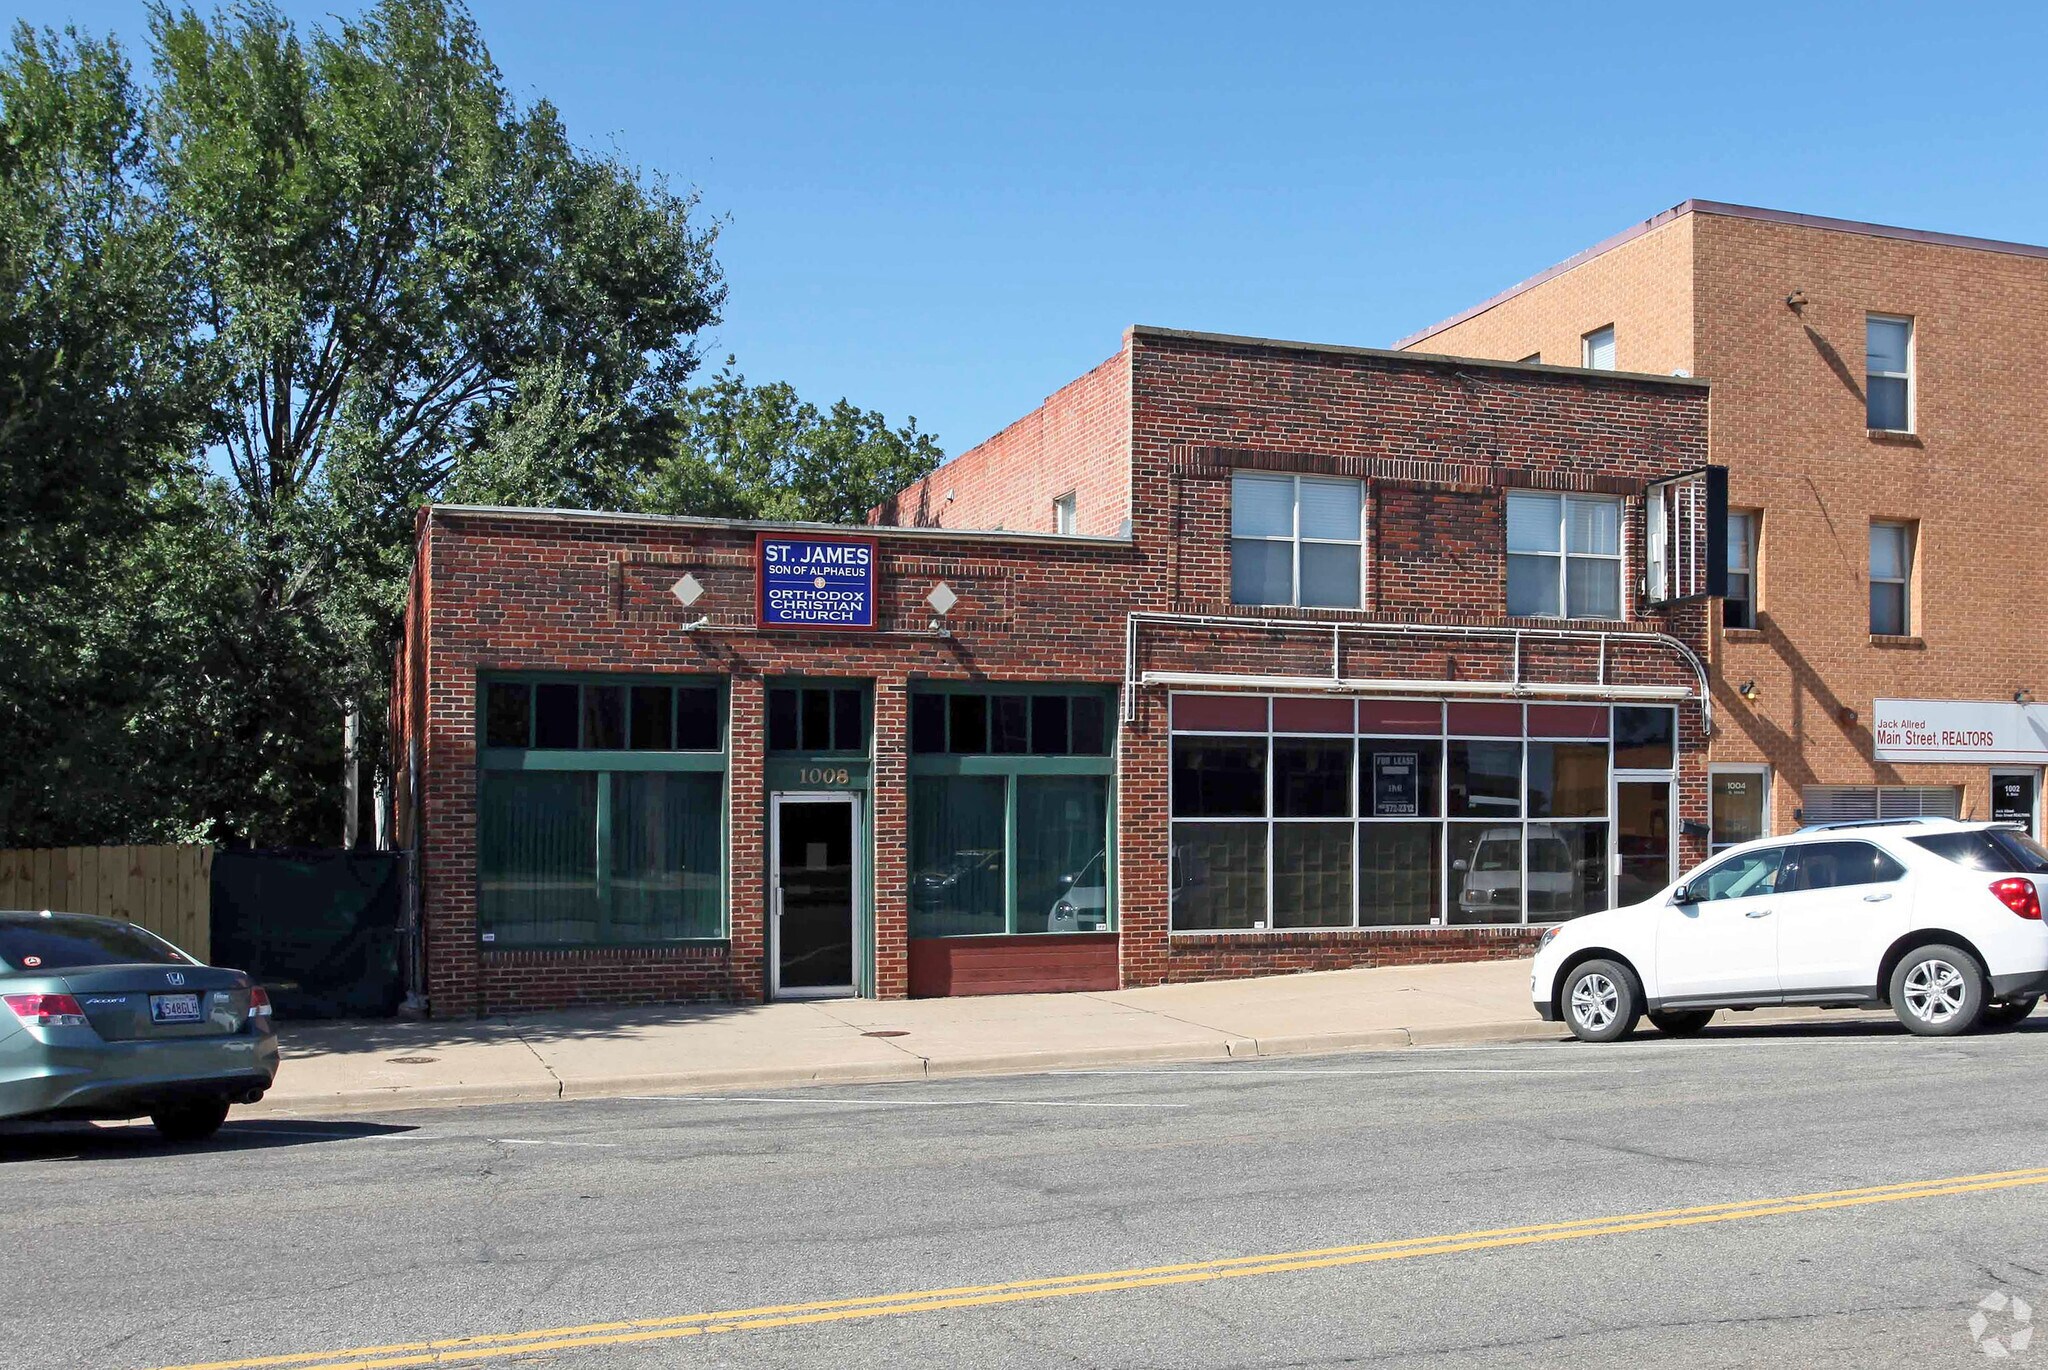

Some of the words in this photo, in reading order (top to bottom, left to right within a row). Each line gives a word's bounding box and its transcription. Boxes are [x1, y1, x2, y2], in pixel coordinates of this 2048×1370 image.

[766, 545, 795, 562] ST.
[800, 546, 869, 564] JAMES
[769, 565, 791, 575] SON
[793, 566, 807, 575] OF
[810, 566, 865, 577] ALPHAEUS
[769, 589, 864, 601] ORTHODOX
[771, 600, 862, 611] CHRISTIAN
[780, 610, 853, 621] CHURCH
[1877, 719, 1898, 729] Jack
[1901, 719, 1926, 729] Allred
[1877, 730, 1901, 745] Main
[1905, 730, 1939, 747] Street,
[1942, 731, 1994, 747] REALTORS
[1377, 756, 1390, 765] FOR
[1393, 756, 1414, 765] LEASE
[800, 768, 849, 784] 1008
[1727, 782, 1746, 790] 1004
[2005, 785, 2020, 793] 1002
[86, 997, 127, 1005] Accord
[165, 1002, 199, 1015] 548GLH
